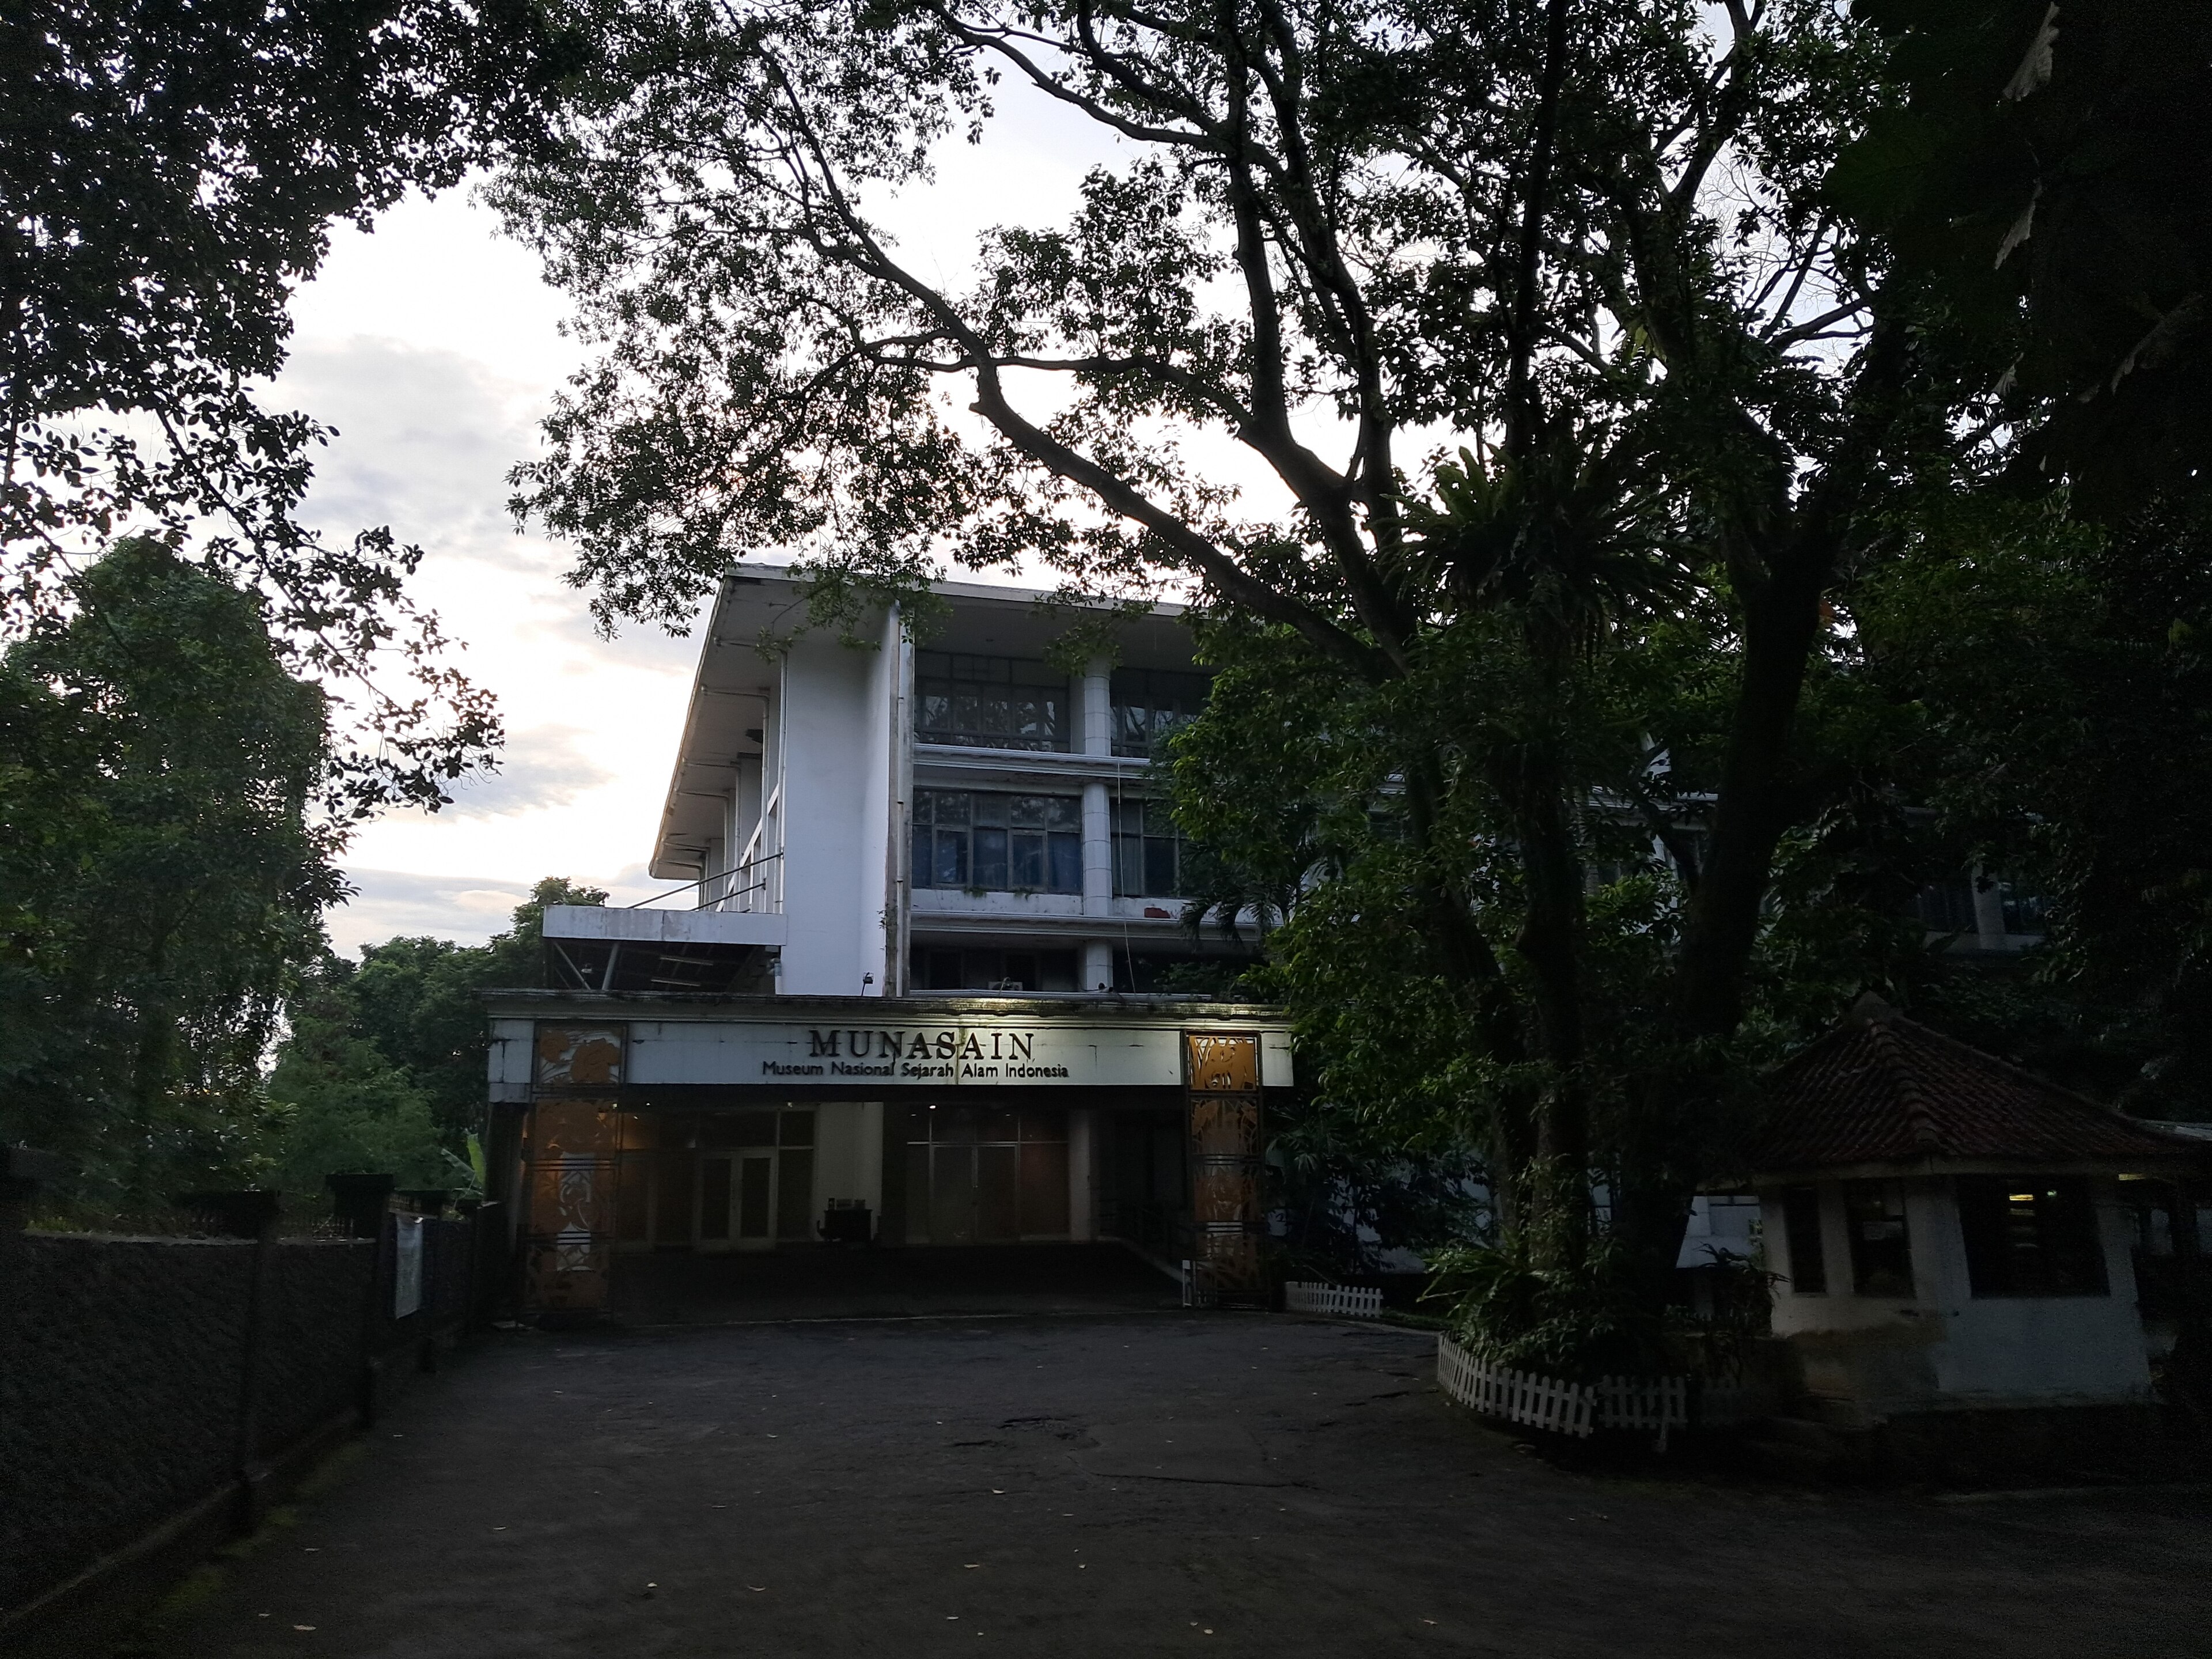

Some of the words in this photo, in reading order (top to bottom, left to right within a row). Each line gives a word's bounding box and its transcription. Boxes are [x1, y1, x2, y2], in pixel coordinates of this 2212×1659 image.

[809, 1030, 1033, 1060] MUNASAIN
[763, 1061, 823, 1075] Museum
[831, 1062, 895, 1075] Nasional
[901, 1062, 954, 1080] Sejarah
[961, 1063, 998, 1077] Alam
[1005, 1063, 1069, 1078] Indonesia
